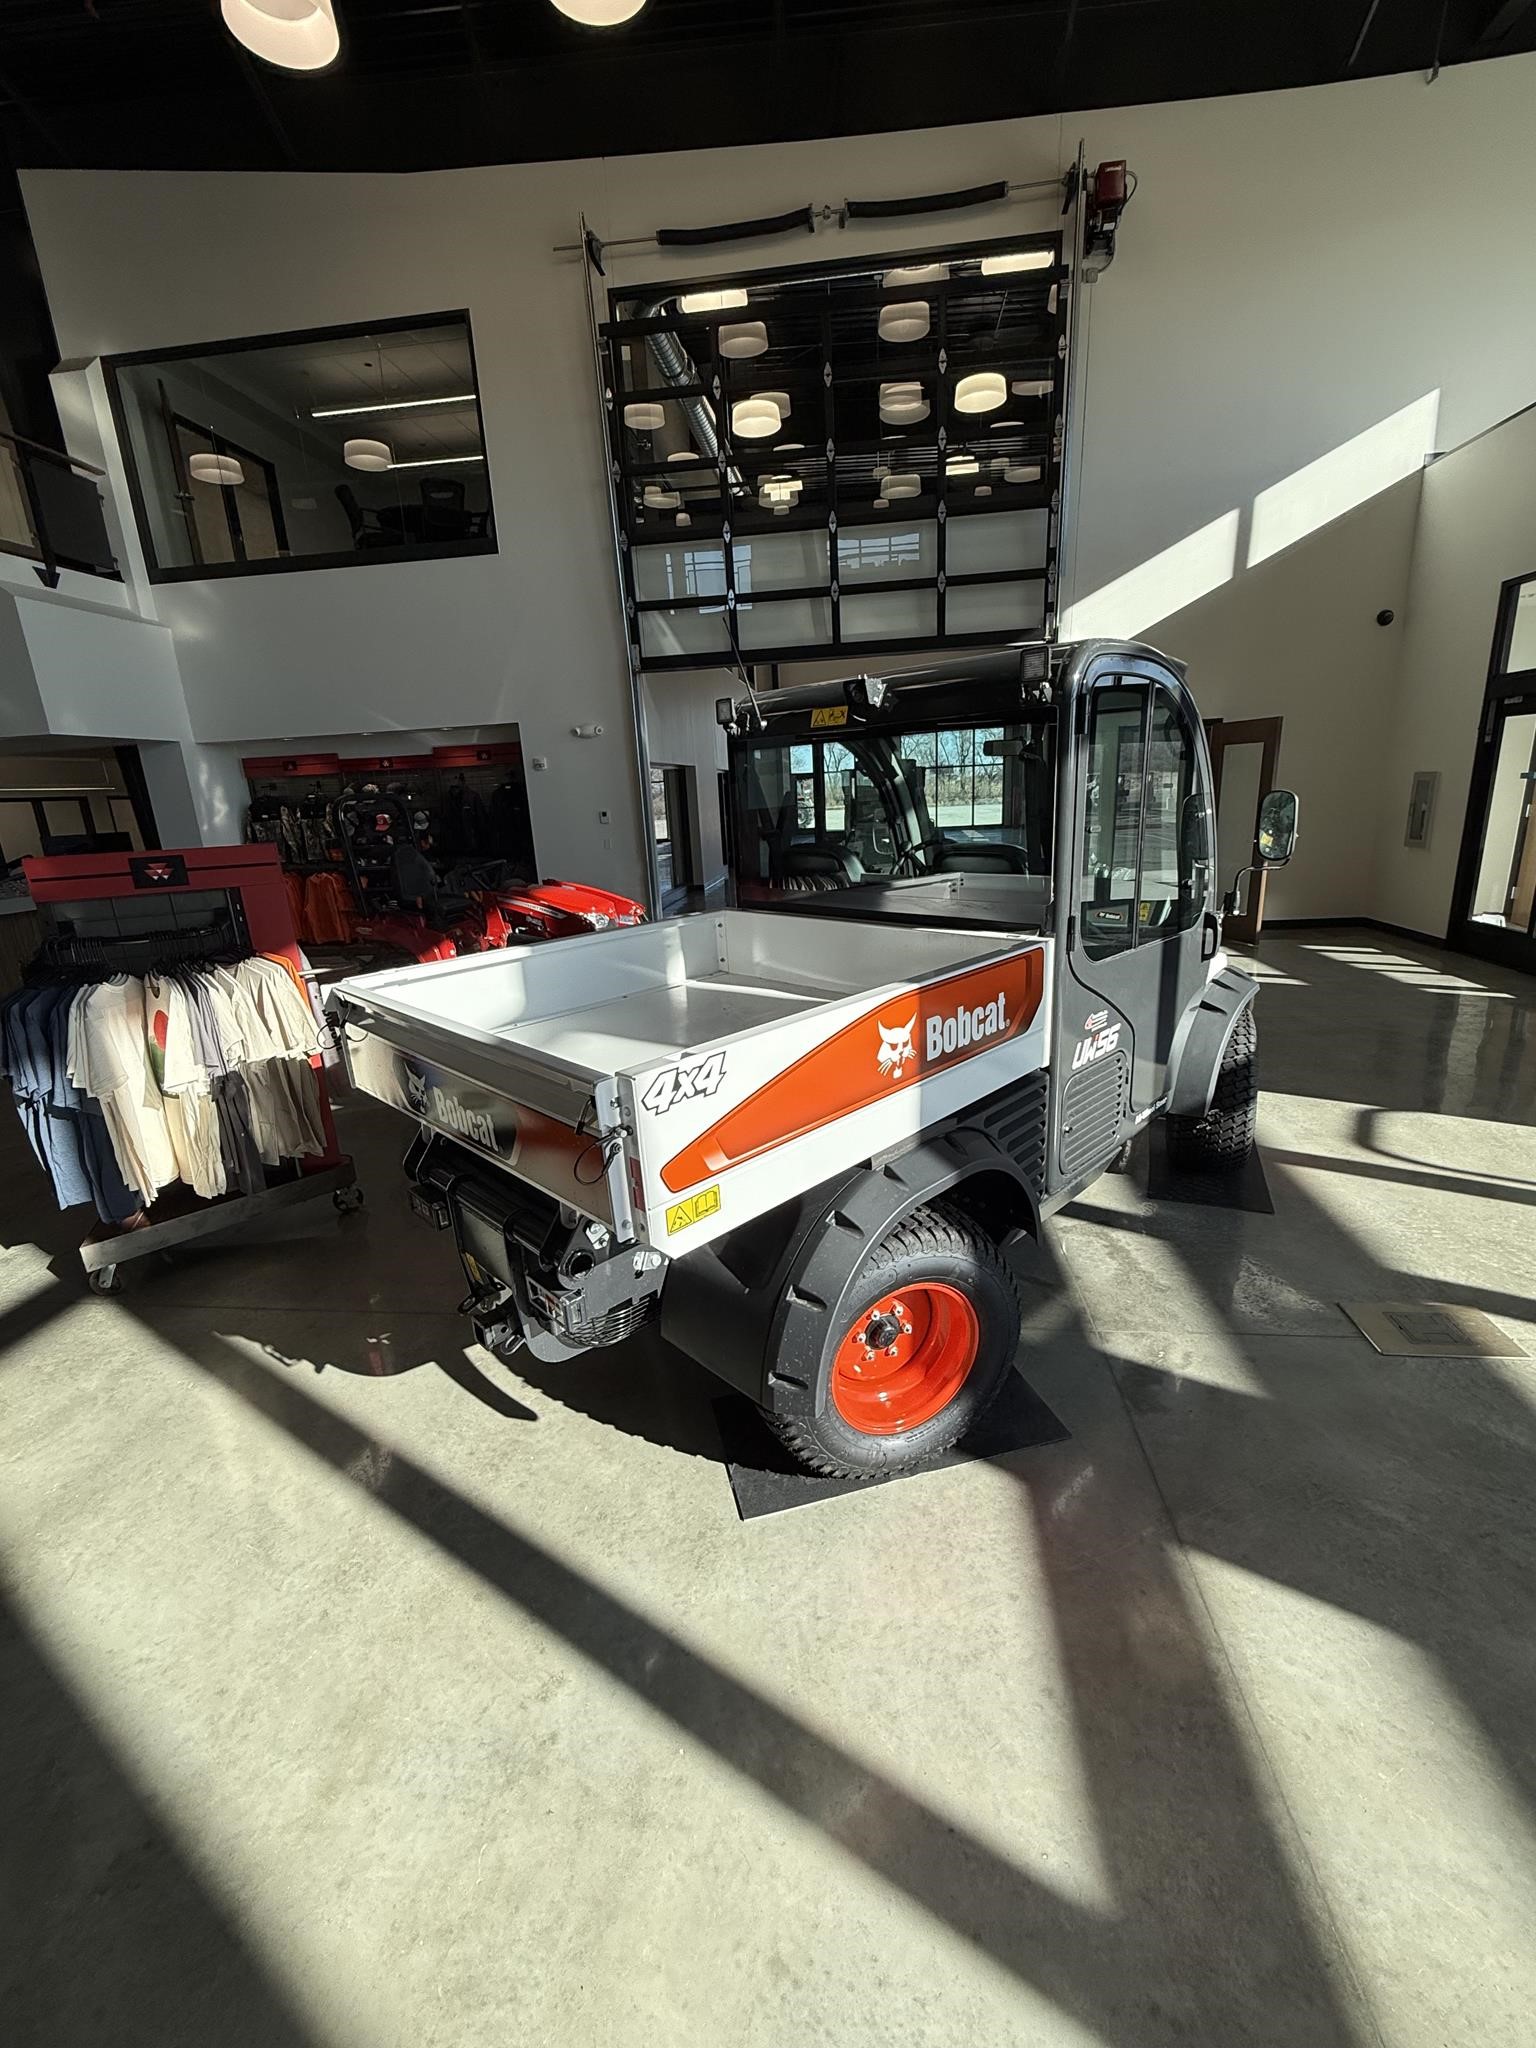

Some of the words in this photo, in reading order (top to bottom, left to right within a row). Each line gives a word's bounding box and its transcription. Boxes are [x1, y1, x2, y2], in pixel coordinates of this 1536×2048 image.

[926, 991, 1006, 1062] Bobcat
[1071, 1022, 1122, 1070] UW56
[641, 1050, 727, 1117] 4x4
[432, 1086, 499, 1152] Bobcat
